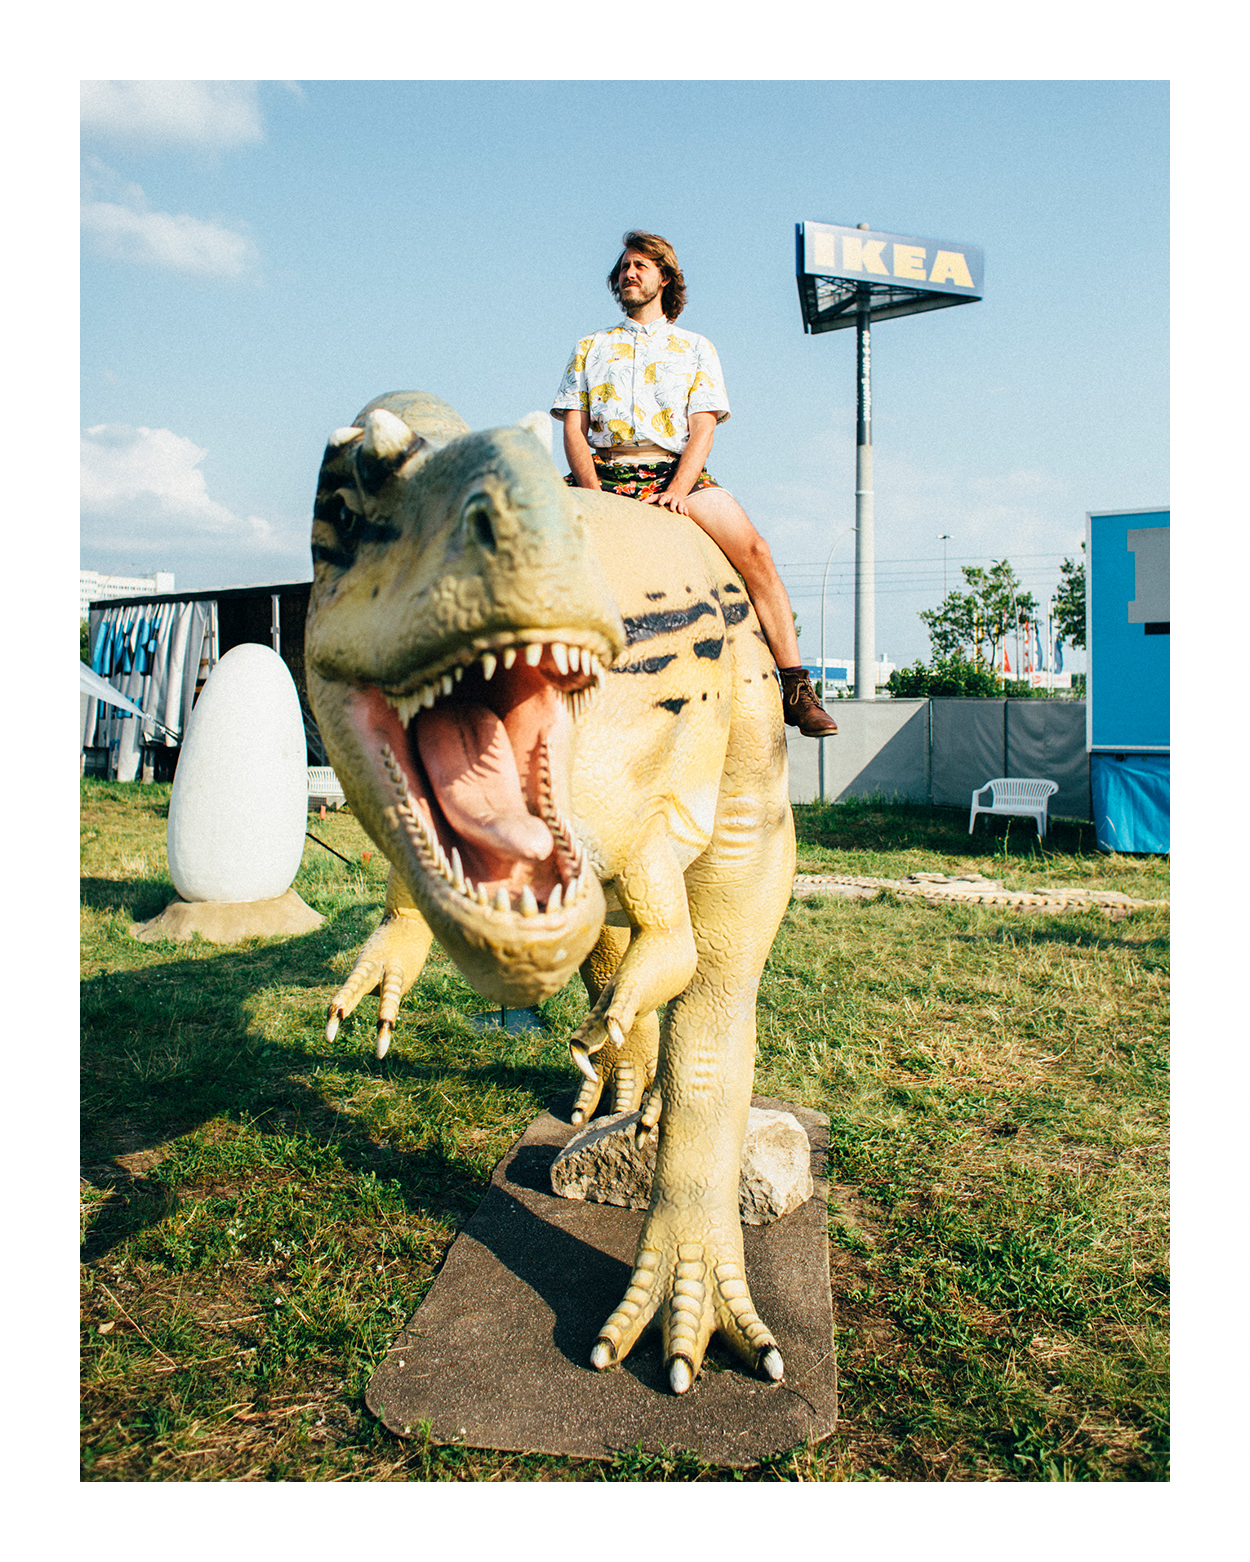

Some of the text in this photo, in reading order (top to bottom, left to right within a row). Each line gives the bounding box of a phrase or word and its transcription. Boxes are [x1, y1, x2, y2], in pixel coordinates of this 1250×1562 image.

[814, 231, 975, 288] IKEA
[861, 330, 871, 422] Ab 9 Uhr geöffnet
